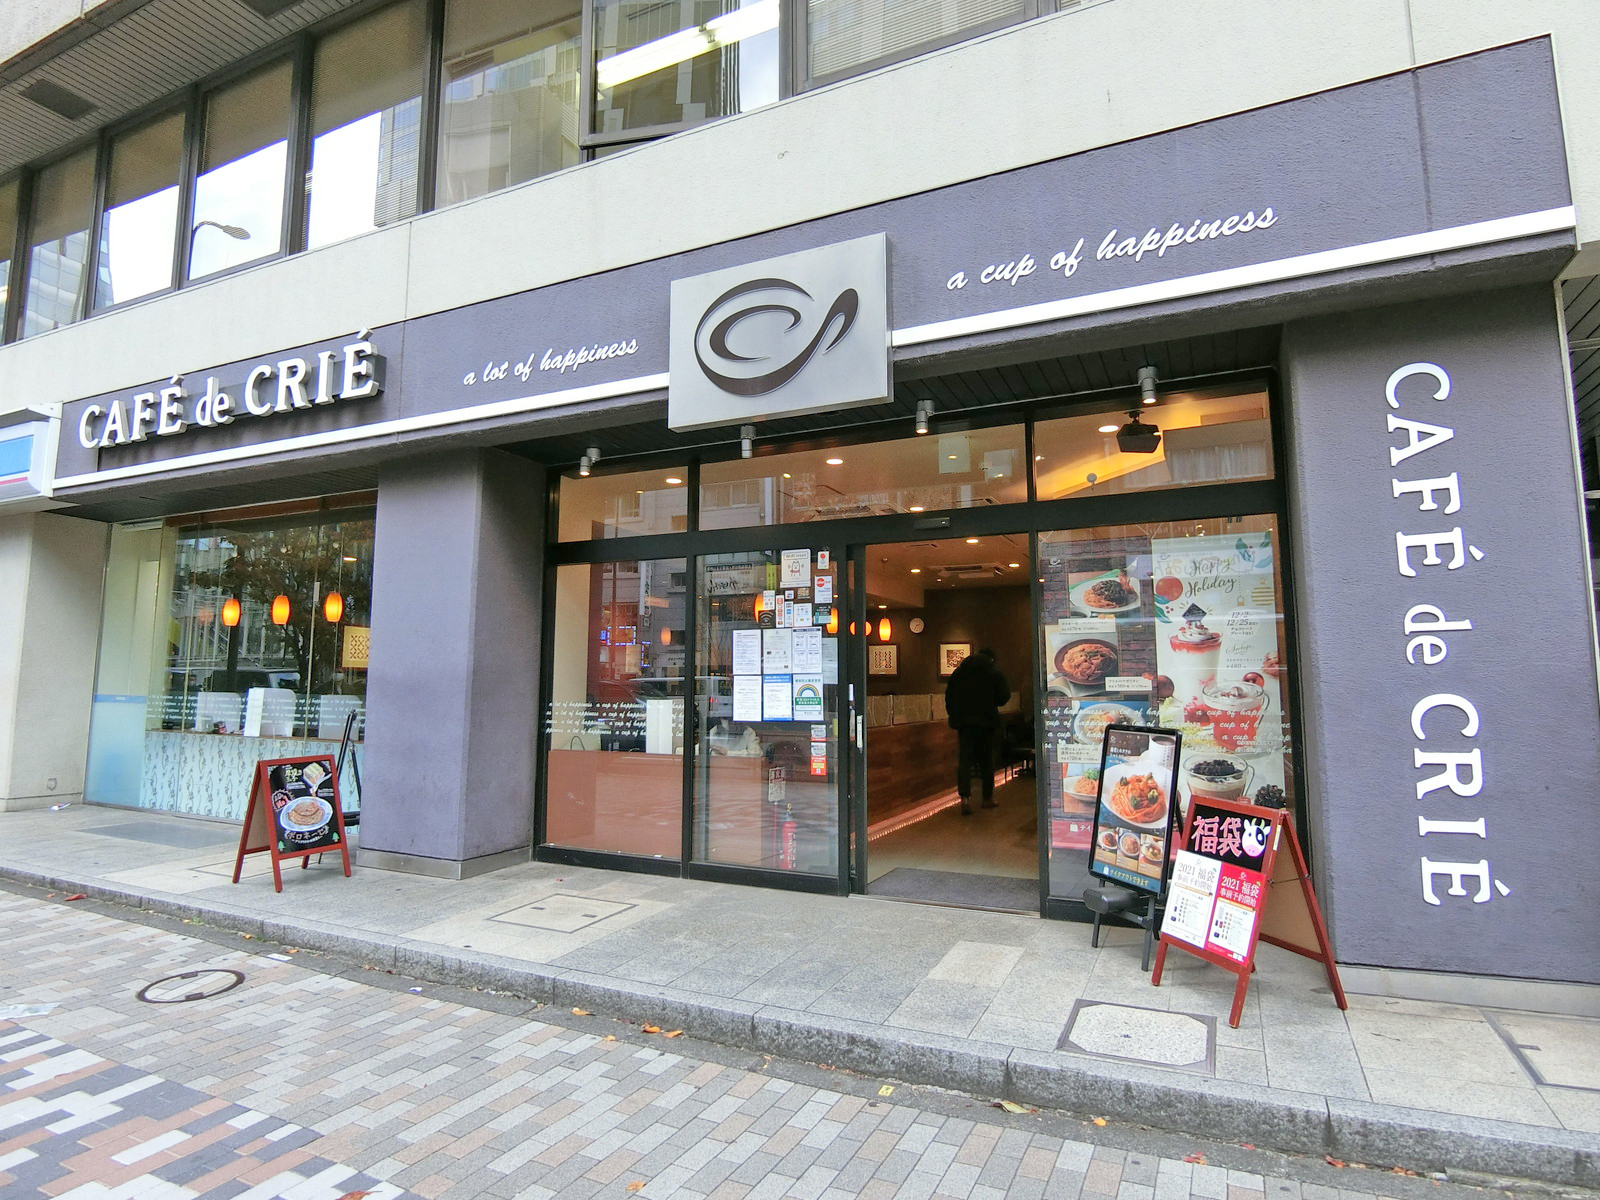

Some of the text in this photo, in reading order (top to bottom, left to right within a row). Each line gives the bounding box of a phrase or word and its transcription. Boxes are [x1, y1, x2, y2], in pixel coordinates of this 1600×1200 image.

[946, 206, 1279, 291] a cup of happiness
[463, 338, 639, 386] a lot of happiness
[78, 327, 379, 449] CAFÉ de CRIÉ
[1190, 557, 1233, 577] Happy
[1185, 576, 1238, 598] Holiday
[1385, 361, 1511, 906] CAFÉ de CRIÉ
[1206, 709, 1222, 718] cup
[1219, 721, 1236, 730] cup
[1232, 734, 1249, 742] cup
[1191, 816, 1243, 857] 福袋
[1110, 868, 1149, 887] テイクアウトできます
[1178, 862, 1216, 884] 2021 福袋
[1220, 887, 1257, 907] 事前予約開始
[1221, 875, 1260, 898] 2021 福袋
